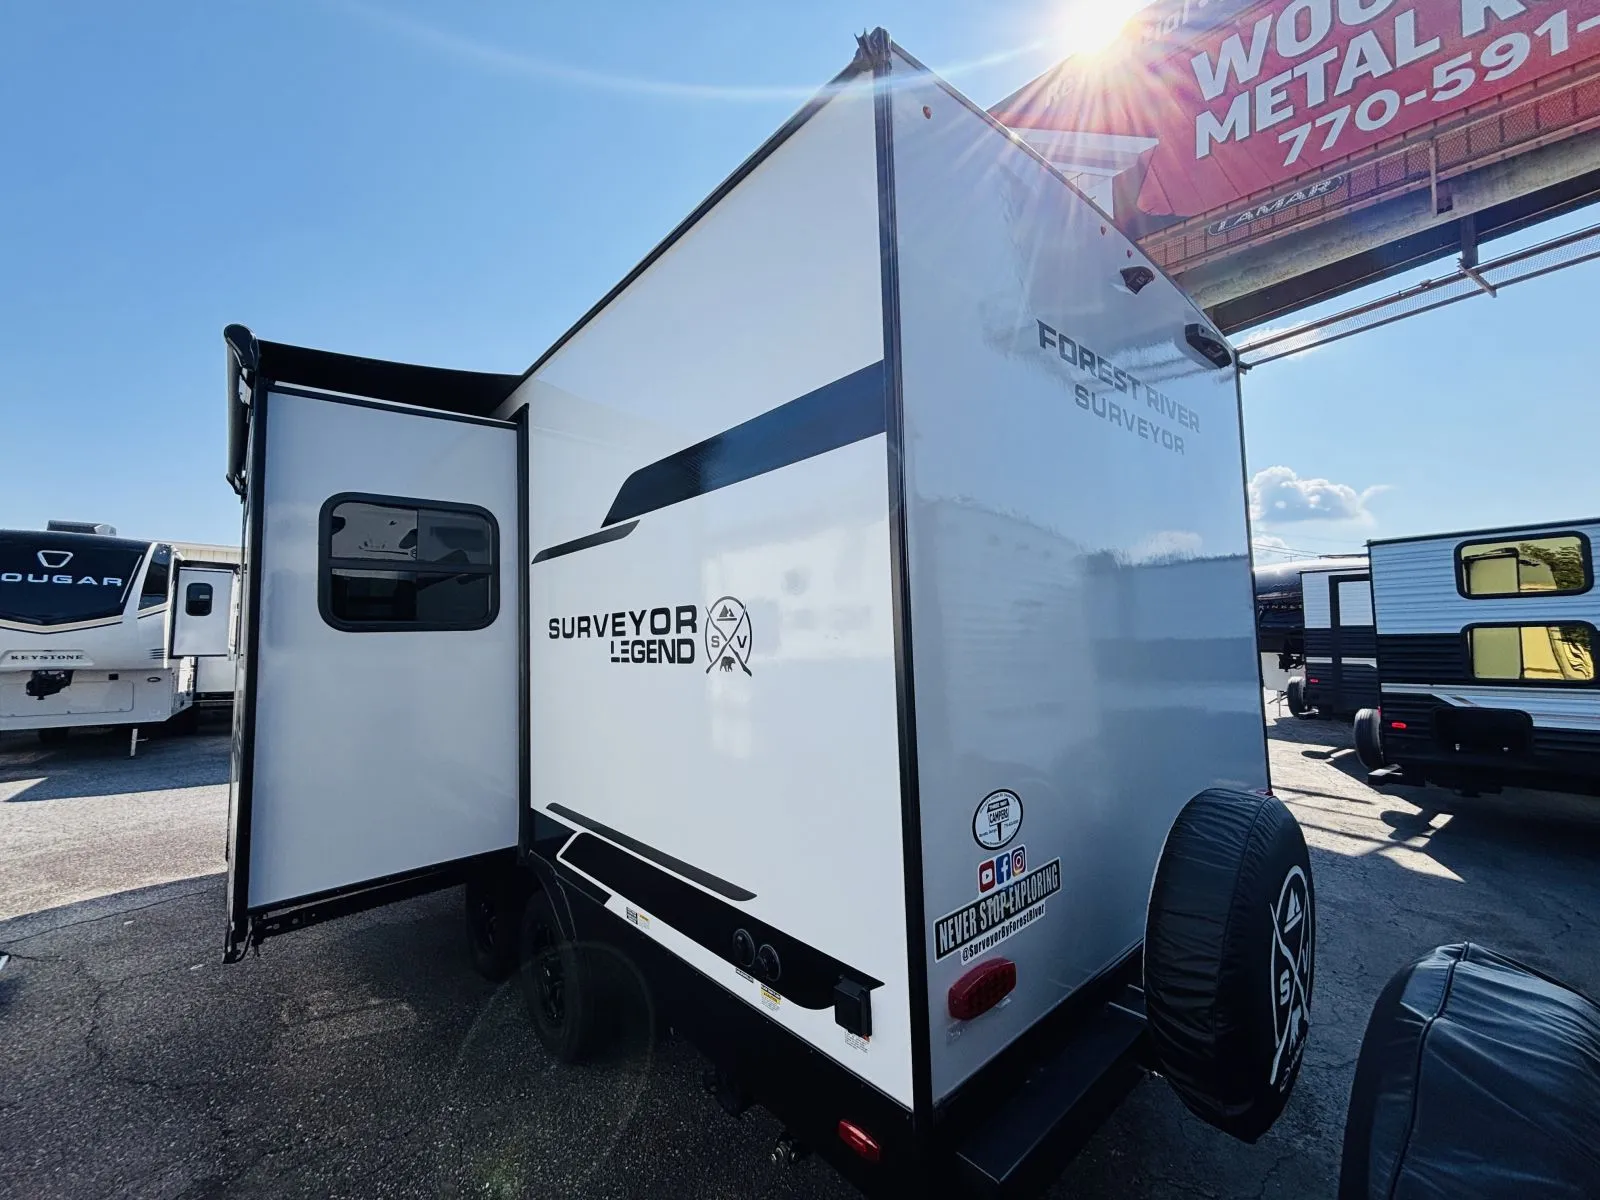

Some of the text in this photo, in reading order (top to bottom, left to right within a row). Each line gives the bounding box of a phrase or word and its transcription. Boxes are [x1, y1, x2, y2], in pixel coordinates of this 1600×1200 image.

[1196, 9, 1440, 160] METAL
[1218, 180, 1332, 232] LAMAR
[1036, 319, 1200, 433] FOREST RIVER
[1075, 384, 1184, 455] SURVEYOR
[549, 604, 697, 639] SURVEYOR
[611, 638, 695, 664] LEGEND
[939, 863, 1058, 954] NEVER STOP EXPLORING
[962, 903, 1045, 961] @SurveyorByForestRiver
